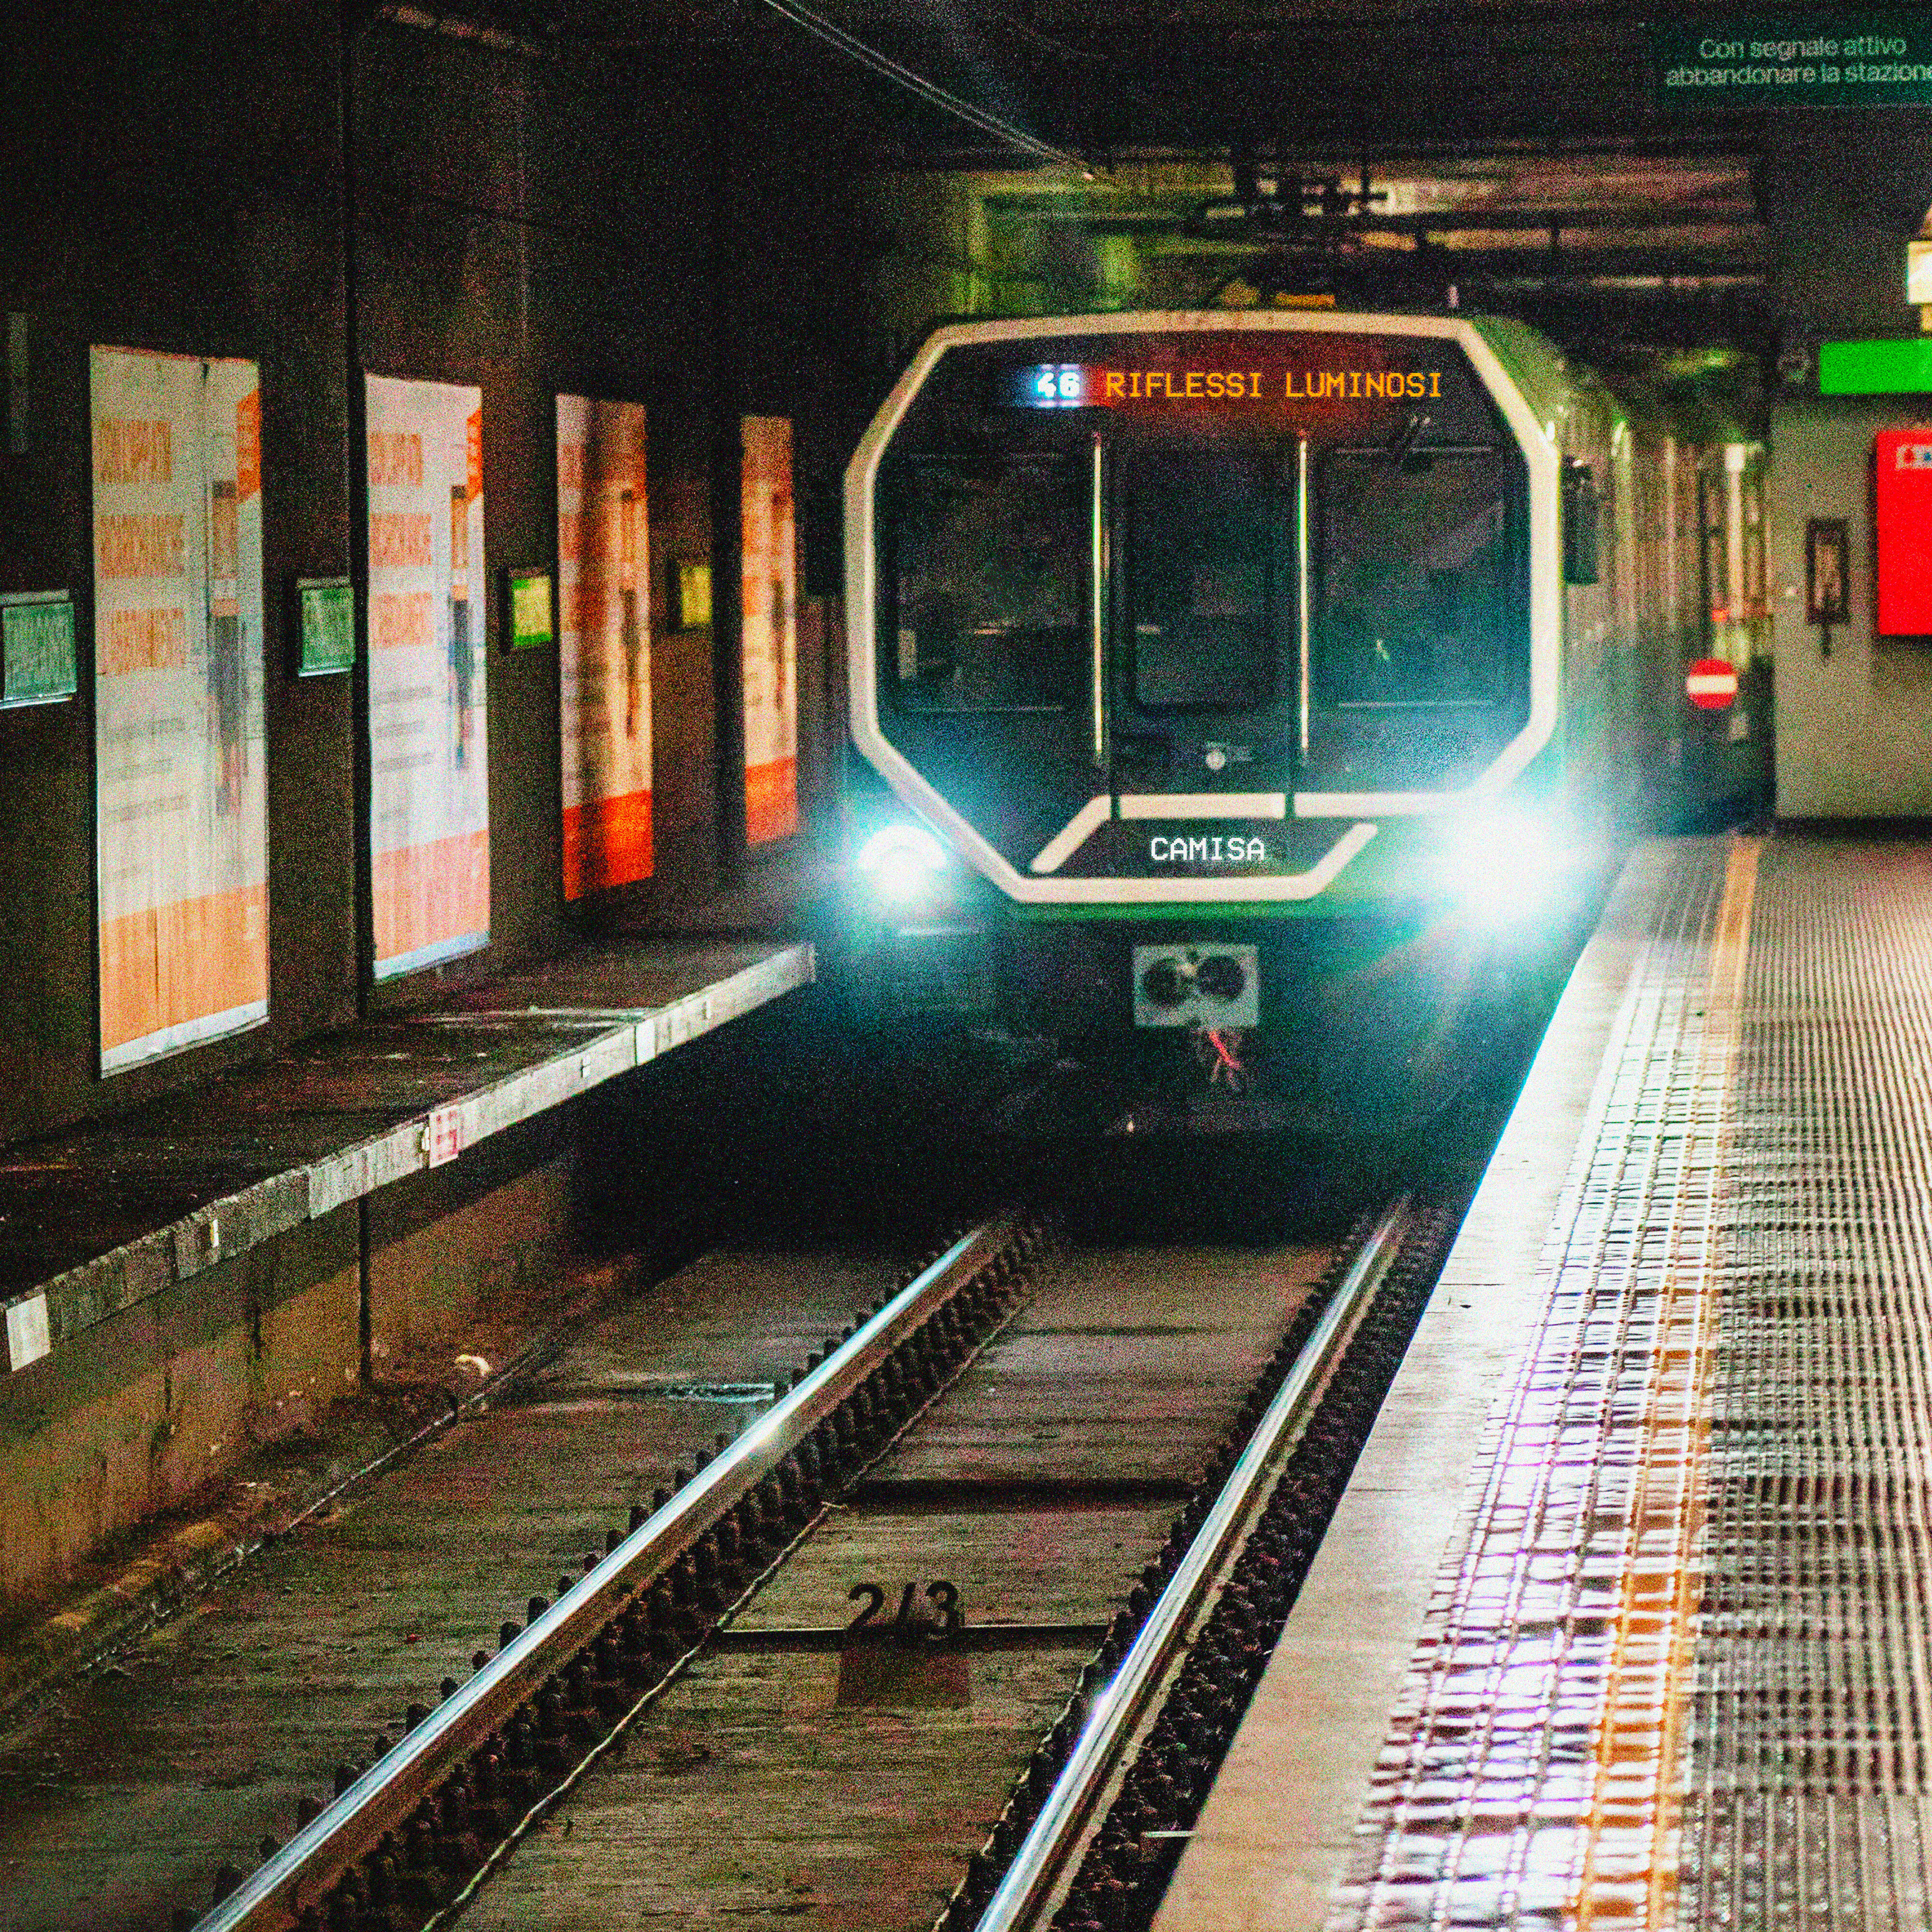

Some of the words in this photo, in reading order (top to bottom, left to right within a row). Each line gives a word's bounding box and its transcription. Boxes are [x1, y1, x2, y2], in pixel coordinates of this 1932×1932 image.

[1700, 39, 1744, 58] Con
[1750, 37, 1838, 61] segnale
[1843, 35, 1906, 56] attivo
[1666, 65, 1816, 86] abbandonare
[1821, 63, 1839, 83] la
[1038, 371, 1079, 397] 46
[1106, 372, 1263, 397] RIFLESSI
[1286, 372, 1441, 397] LUMINOSI
[1151, 838, 1264, 860] CAMISA
[848, 1580, 959, 1642] 2/3
